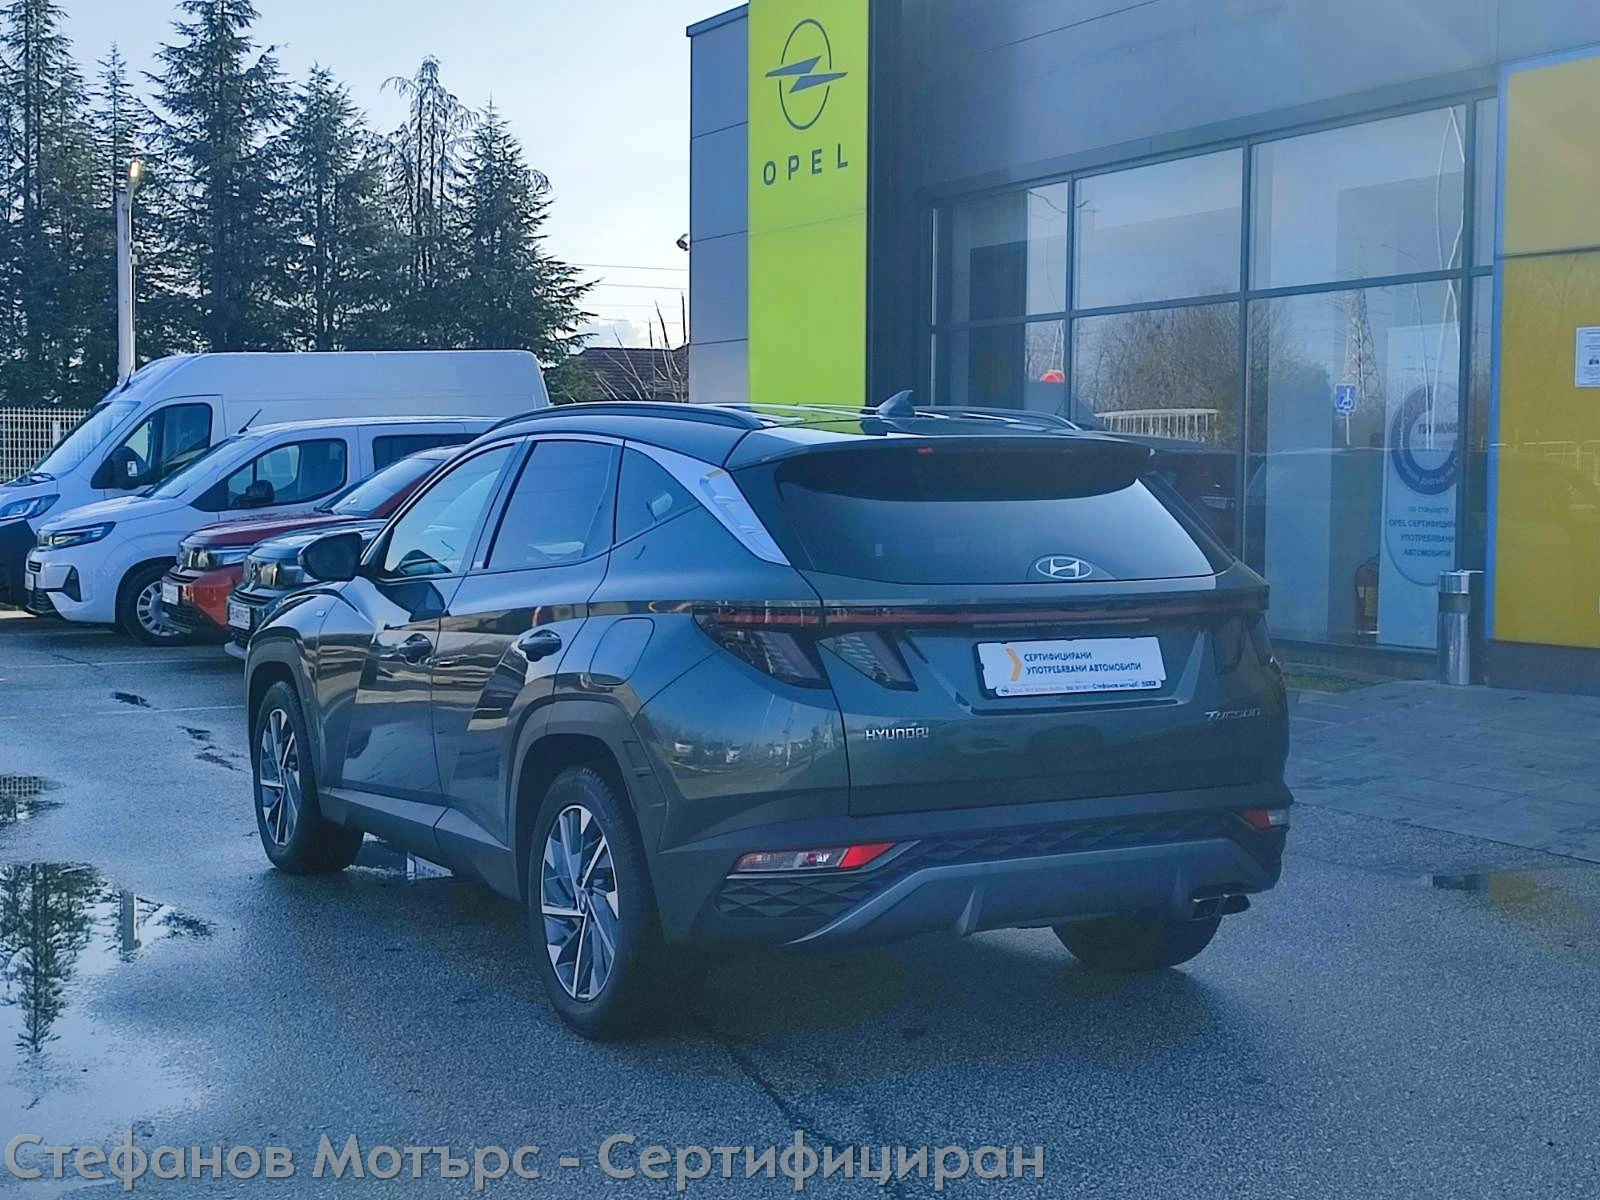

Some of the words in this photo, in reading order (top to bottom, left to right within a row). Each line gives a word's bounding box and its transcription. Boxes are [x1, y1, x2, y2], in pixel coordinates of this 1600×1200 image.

[763, 143, 849, 186] OPEL
[1024, 652, 1093, 662] СЕРТИФИЦИРАНИ
[1026, 664, 1087, 675] УПОТРЕБЯВАНИ
[1088, 662, 1142, 673] АВТОМОБИЛИ
[865, 727, 929, 741] HYUNDAI
